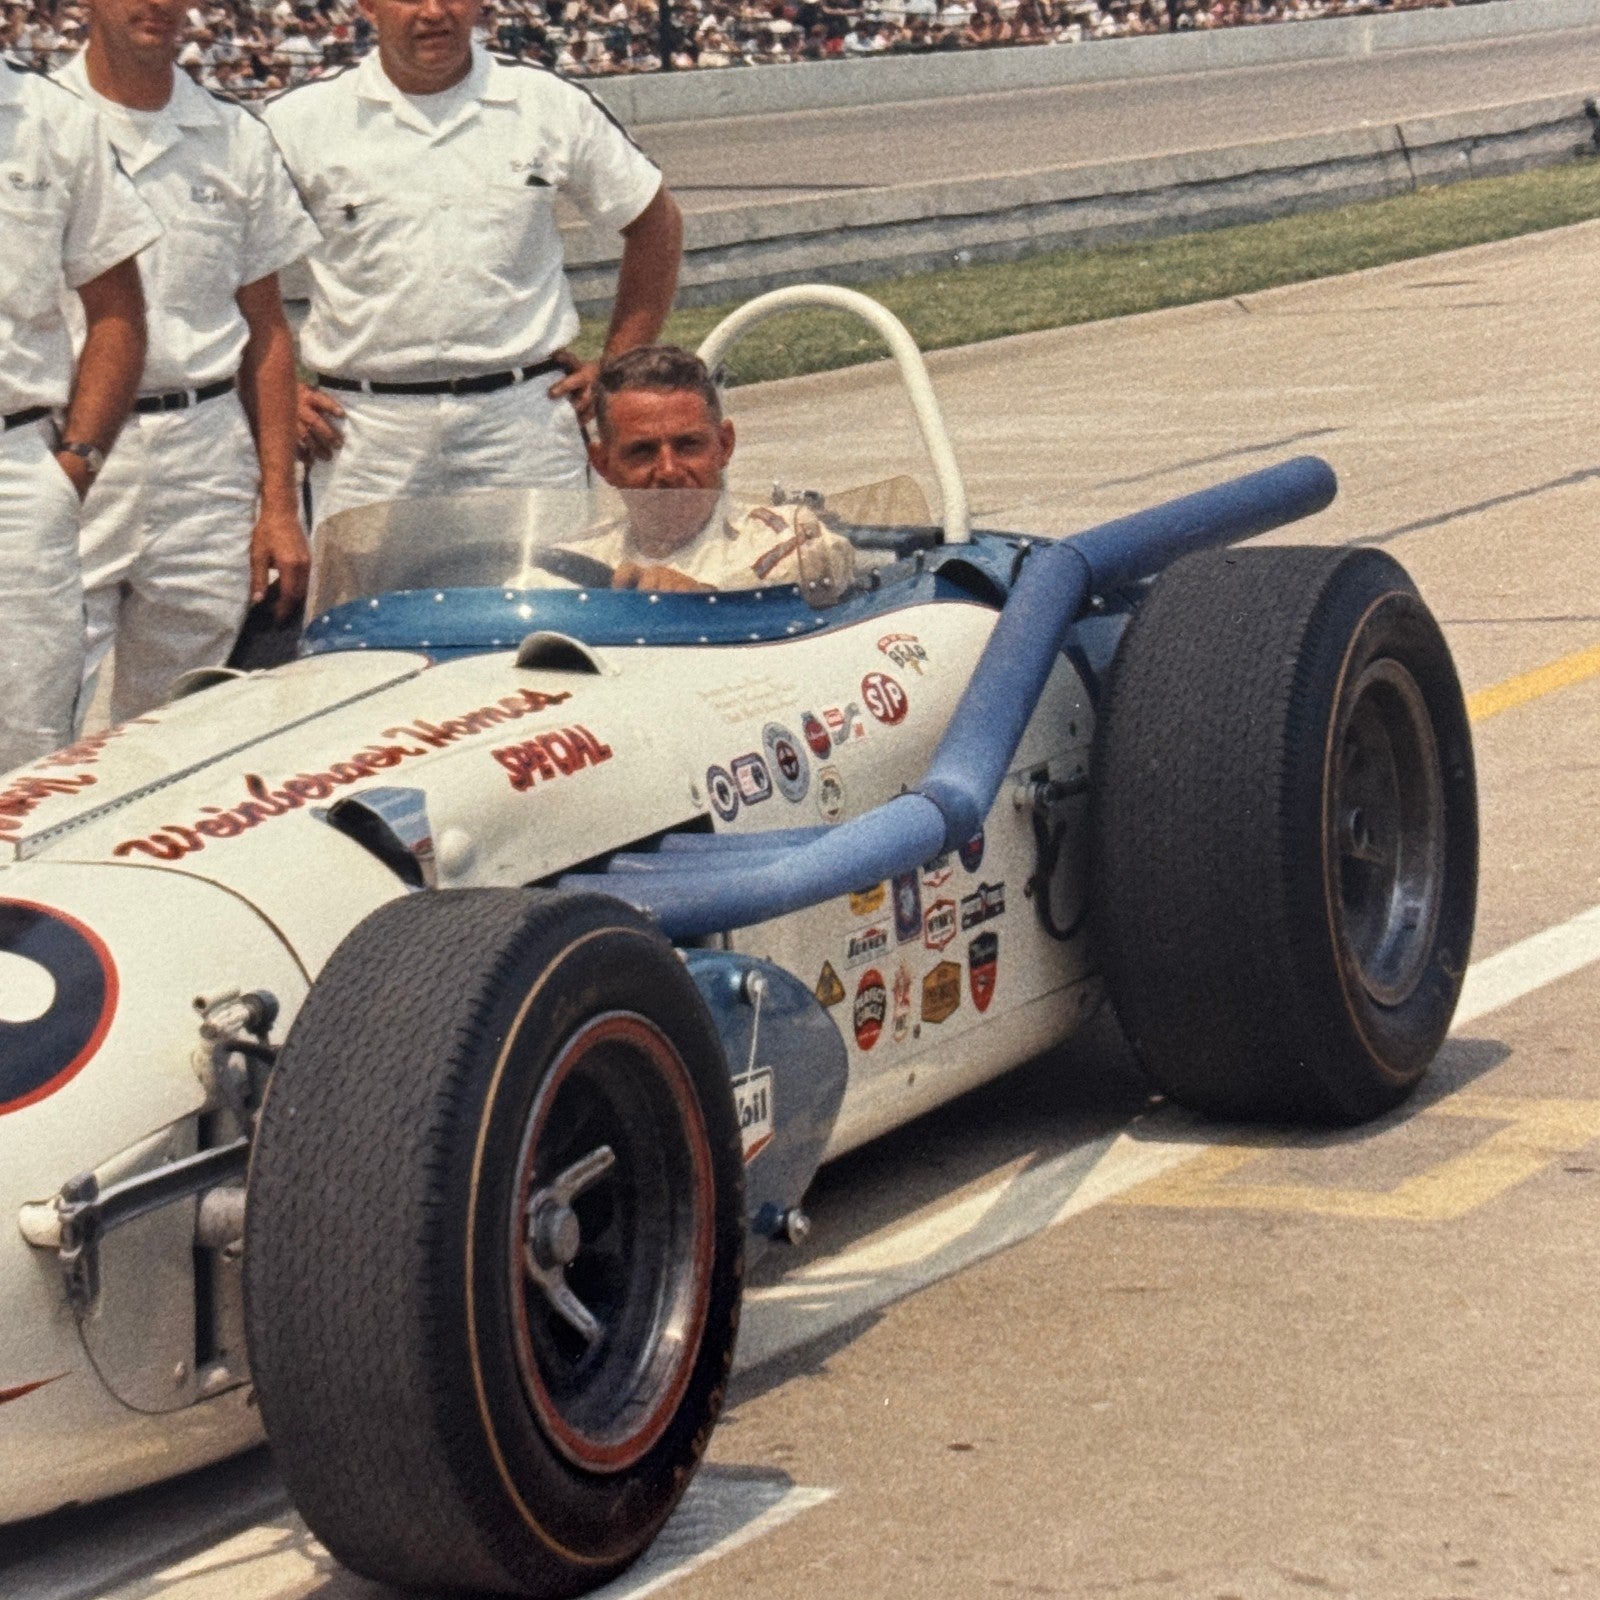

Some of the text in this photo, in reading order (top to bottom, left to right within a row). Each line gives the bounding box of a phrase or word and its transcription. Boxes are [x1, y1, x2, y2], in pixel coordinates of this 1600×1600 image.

[865, 673, 903, 720] STP
[112, 743, 428, 861] Weinberger
[382, 688, 573, 749] Homes
[492, 724, 613, 793] SPECIAL
